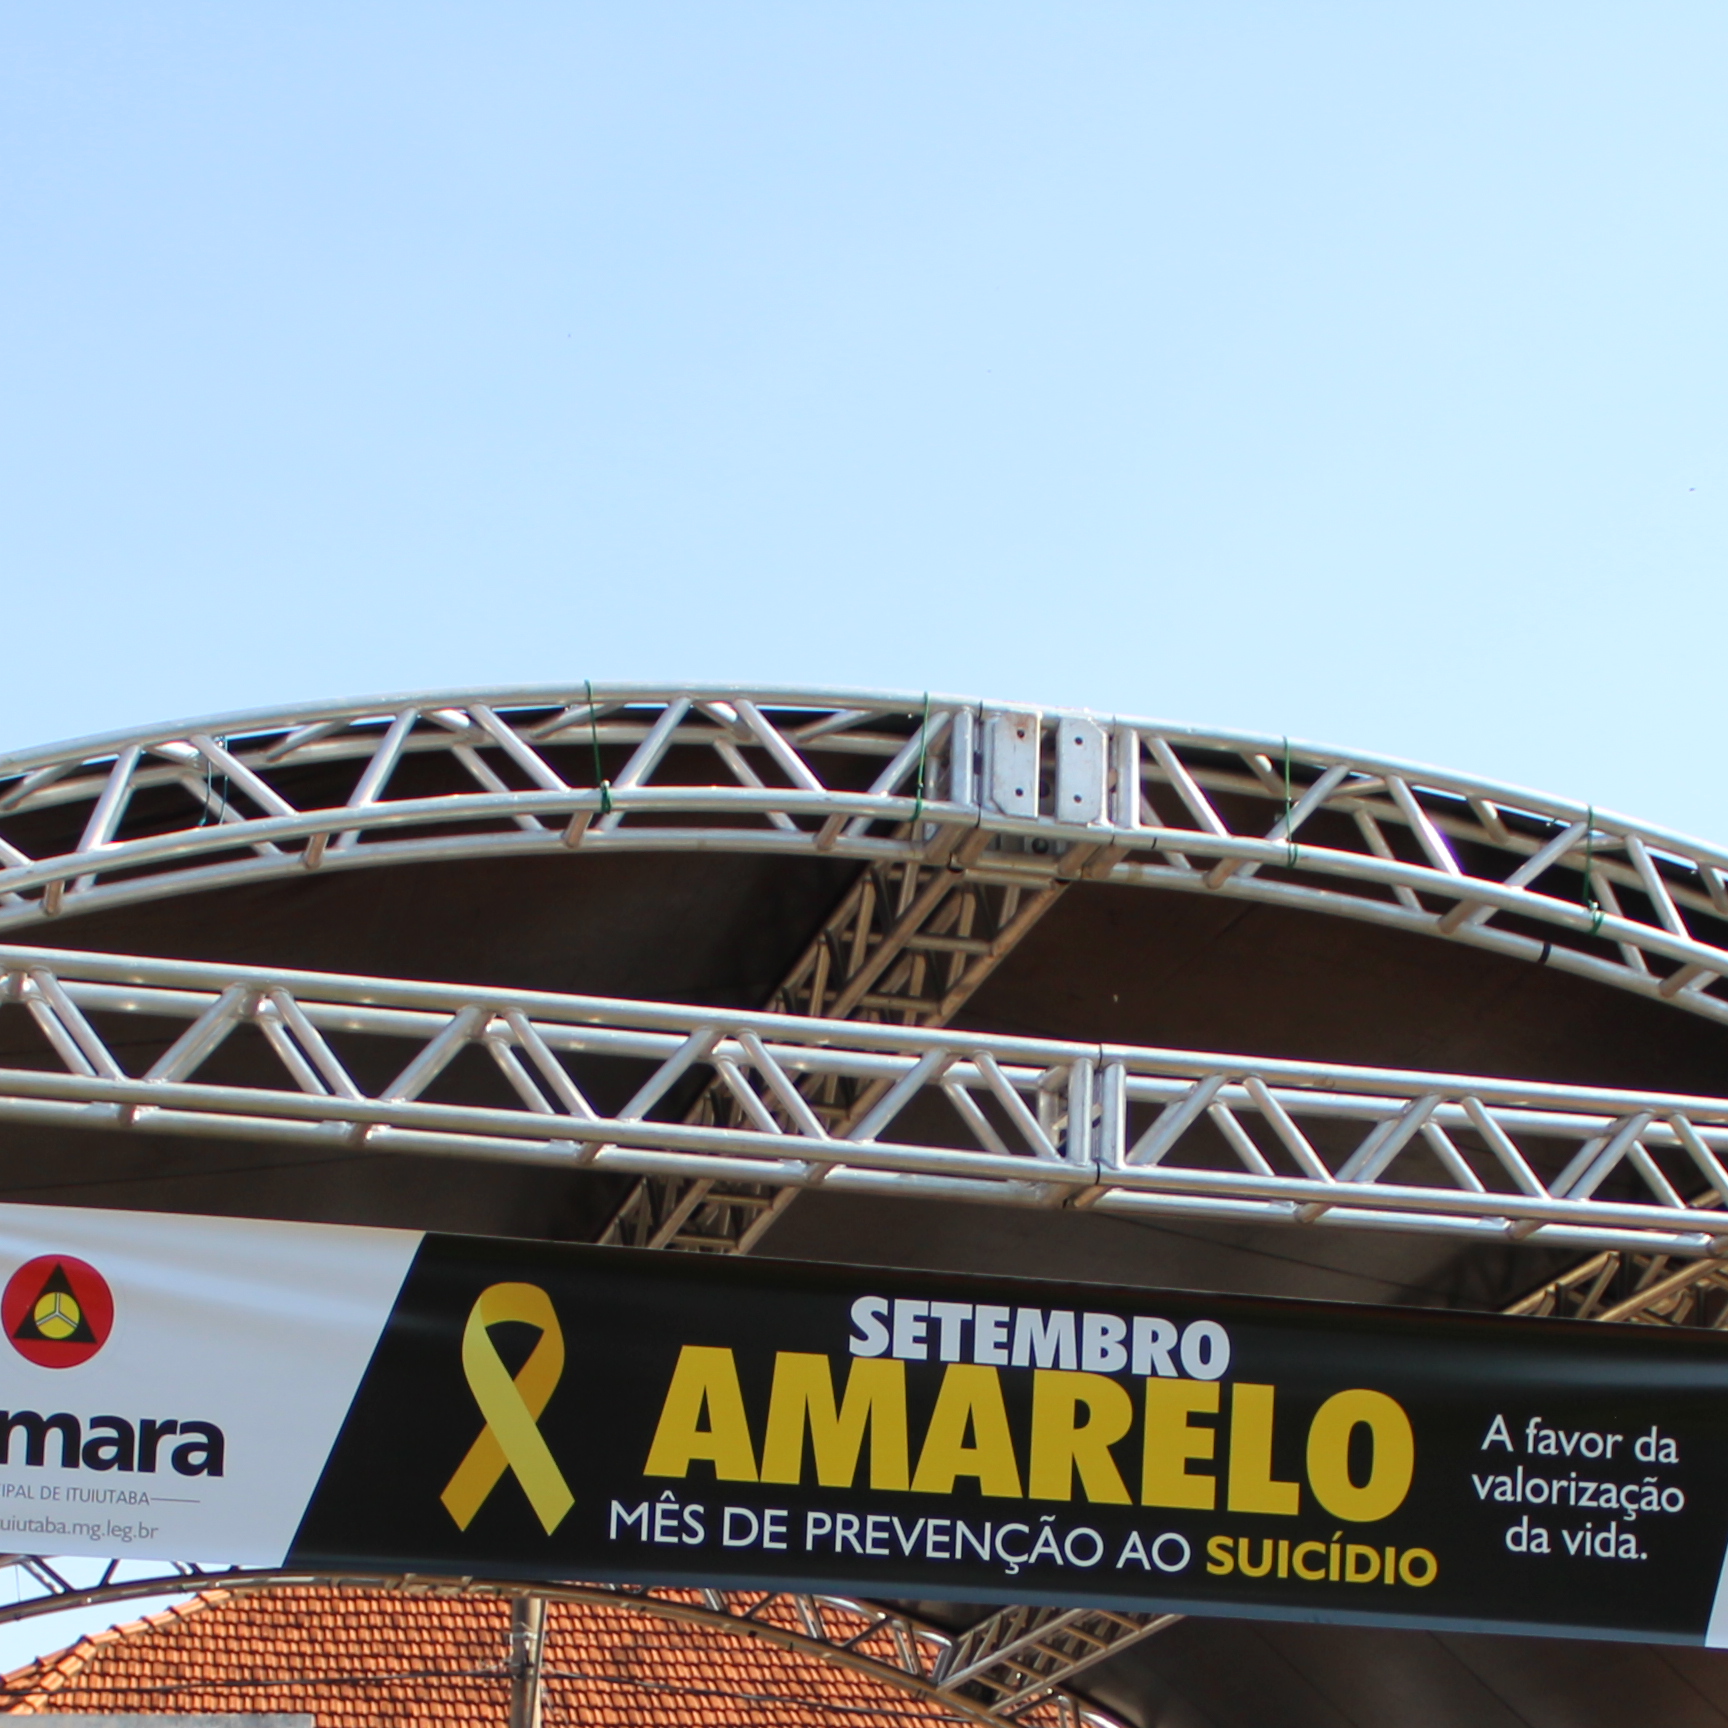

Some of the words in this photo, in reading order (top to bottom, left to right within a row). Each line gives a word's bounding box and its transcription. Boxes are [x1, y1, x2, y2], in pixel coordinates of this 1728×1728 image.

[849, 1296, 1232, 1380] SETEMBRO
[643, 1345, 1415, 1522] AMARELO
[1481, 1414, 1514, 1452] A
[1525, 1417, 1624, 1460] favor
[1635, 1424, 1679, 1465] da
[39, 1485, 63, 1502] DE
[65, 1487, 151, 1506] ITUIUTABA
[1472, 1466, 1686, 1520] valorização
[609, 1491, 706, 1545] MÊS
[723, 1508, 788, 1550] DE
[805, 1511, 1104, 1574] PREVENÇÃO
[1116, 1530, 1192, 1574] AO
[1205, 1530, 1438, 1588] SUICÍDIO
[1505, 1517, 1551, 1555] da
[1562, 1521, 1649, 1562] vida.
